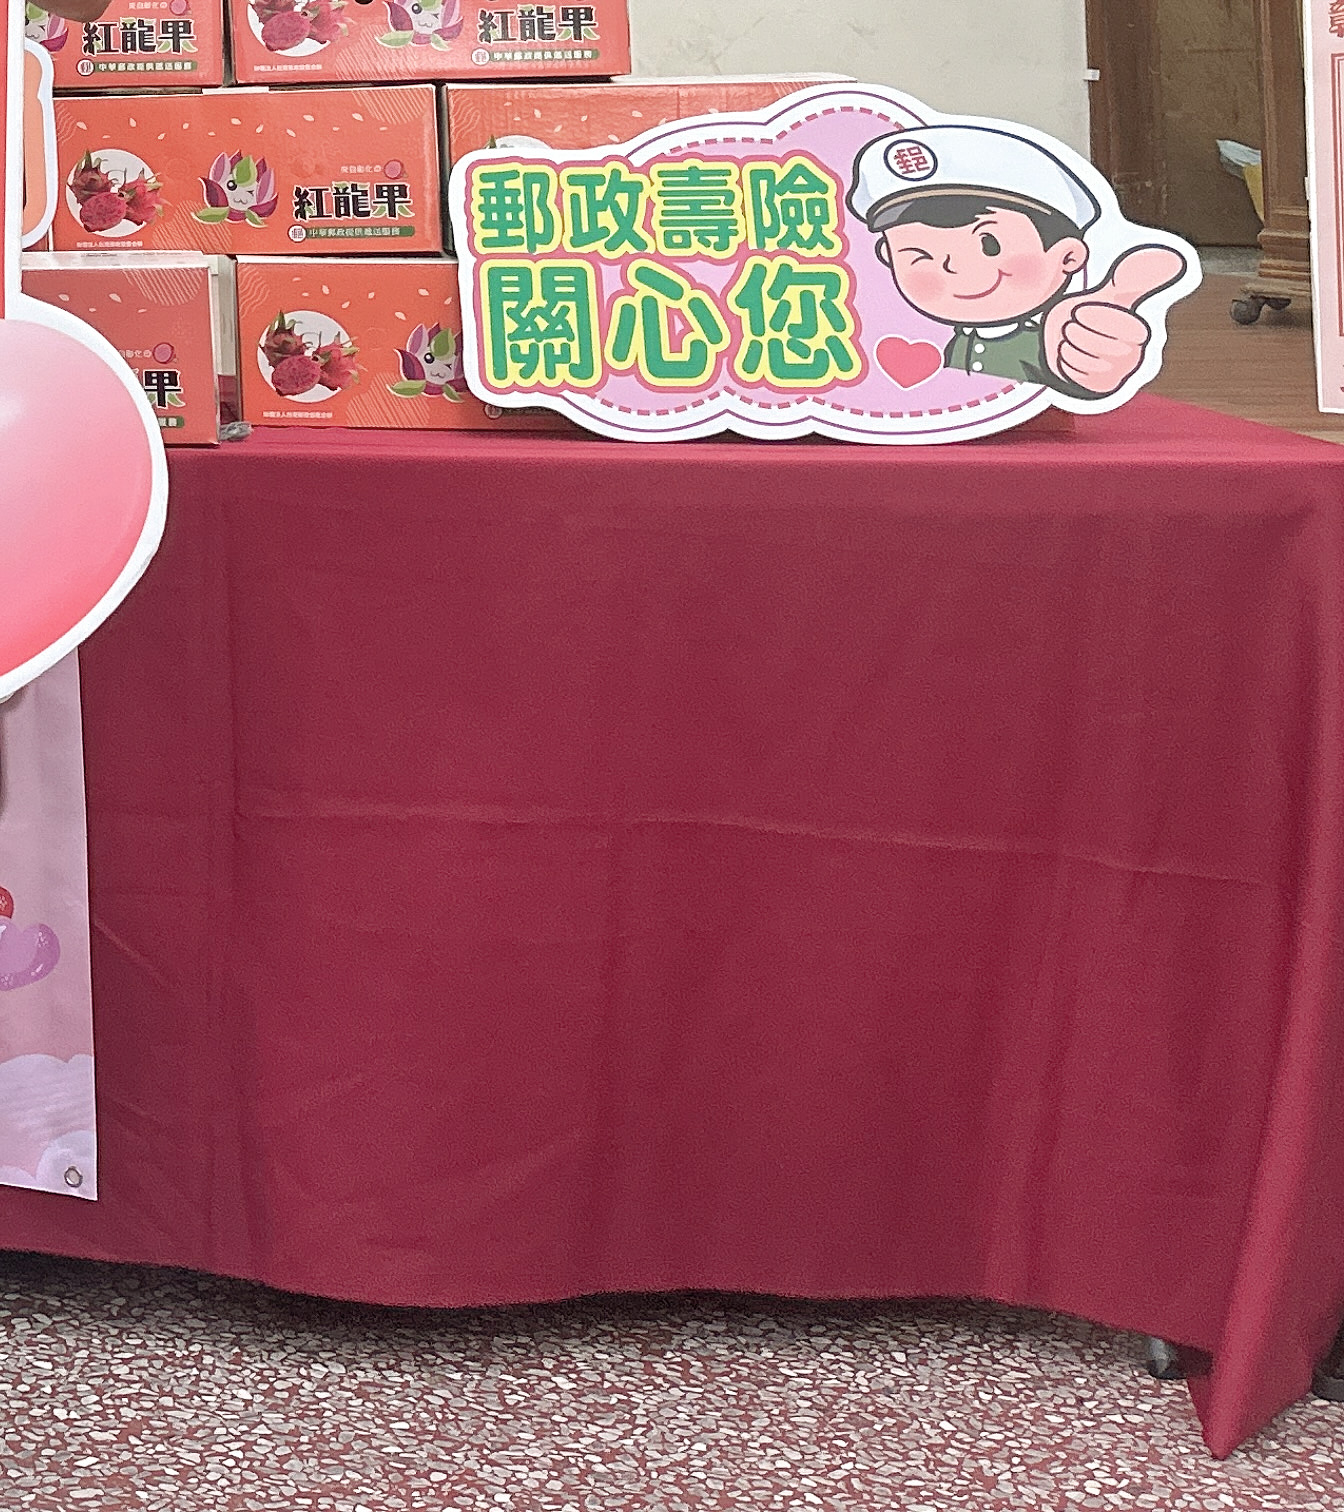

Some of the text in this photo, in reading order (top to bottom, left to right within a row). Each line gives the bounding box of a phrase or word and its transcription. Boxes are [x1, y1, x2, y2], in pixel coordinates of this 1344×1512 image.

[81, 16, 199, 56] 紅龍果
[477, 3, 601, 45] 紅龍果
[292, 180, 416, 222] 紅龍果
[476, 161, 842, 255] 郵政壽險
[486, 263, 857, 385] 關心您
